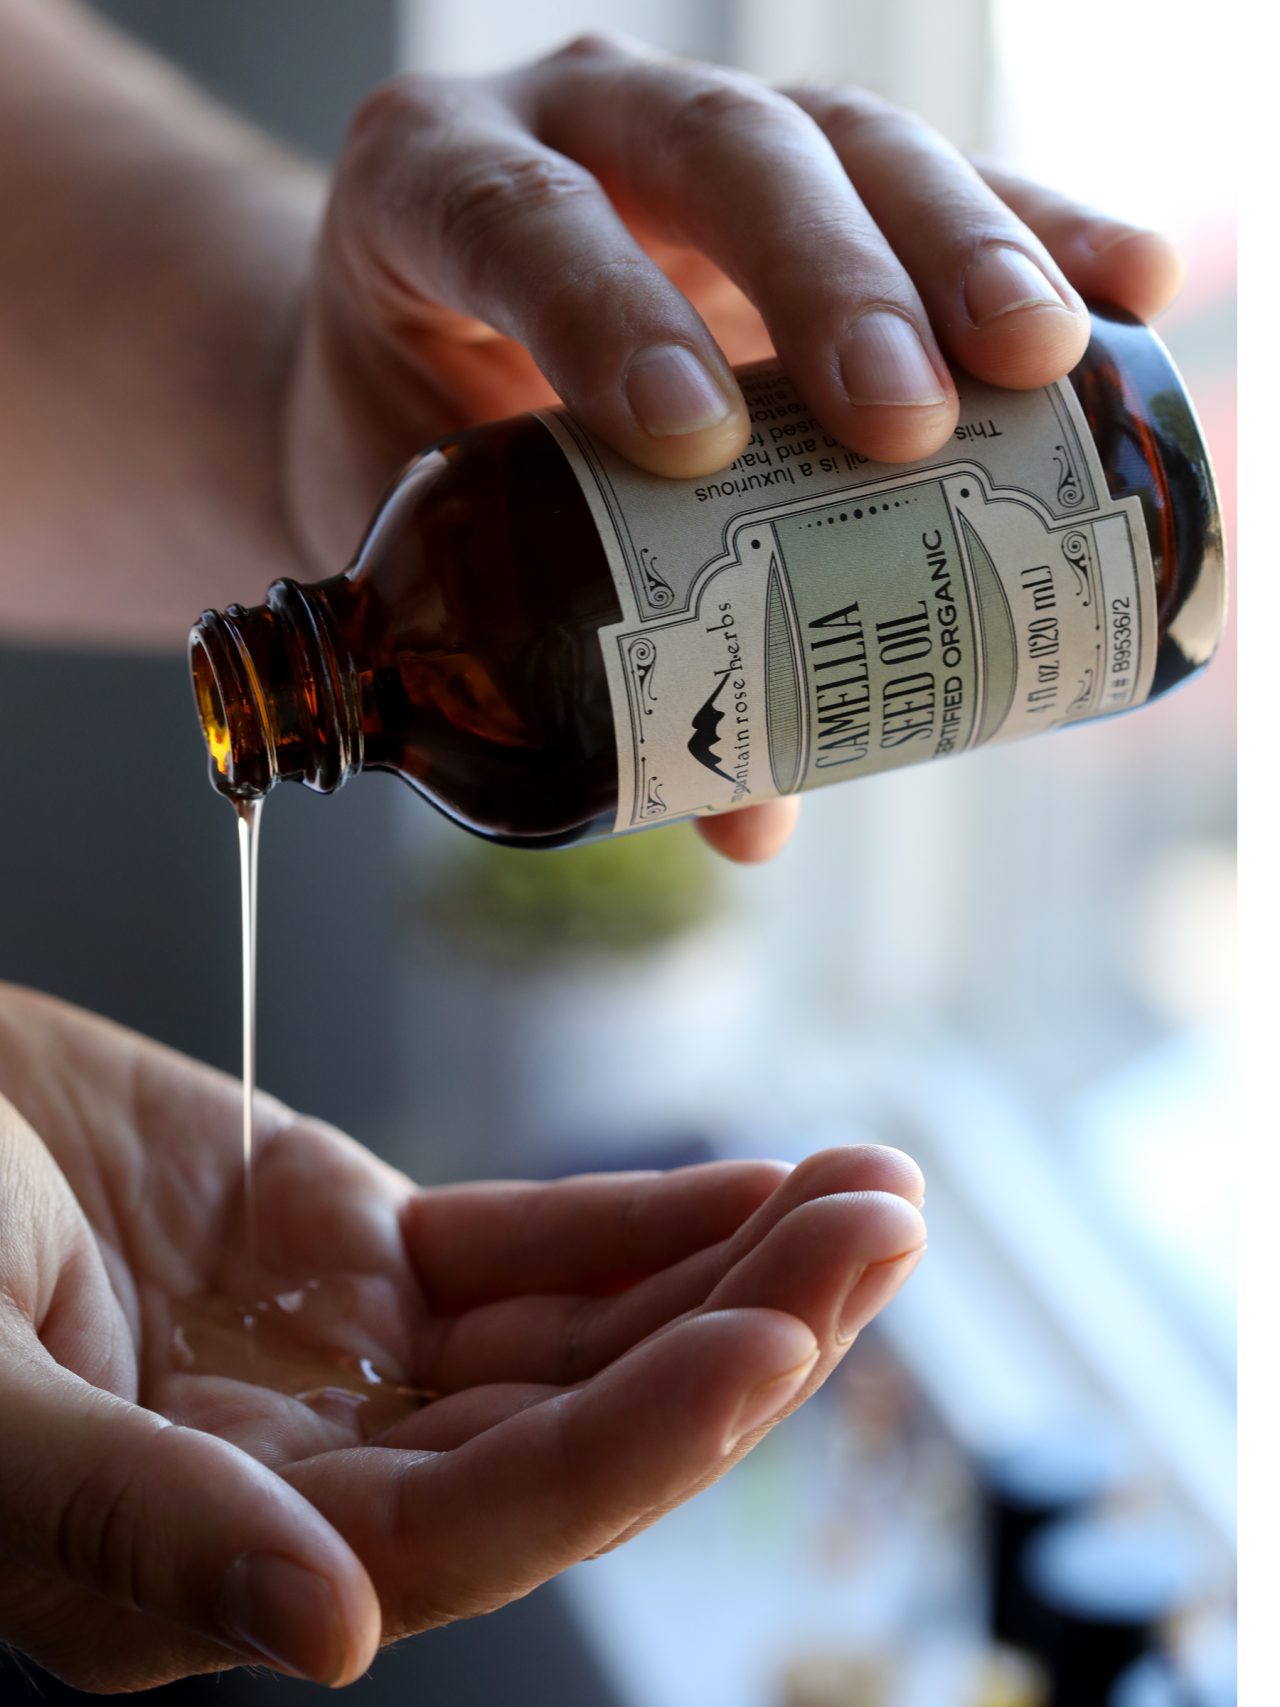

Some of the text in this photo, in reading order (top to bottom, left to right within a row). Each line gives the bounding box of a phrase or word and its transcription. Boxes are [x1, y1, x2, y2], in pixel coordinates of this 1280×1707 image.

[953, 419, 1003, 443] This
[731, 450, 773, 473] hair
[776, 439, 817, 463] and
[798, 462, 814, 477] a
[819, 456, 841, 475] is
[694, 466, 796, 502] luxurious
[922, 529, 962, 669] ORGANIC
[1020, 565, 1056, 611] mL)
[706, 602, 743, 677] herbs
[1027, 617, 1060, 659] (120
[1112, 596, 1131, 674] B9536/2
[808, 601, 871, 769] CAMELLIA
[875, 600, 936, 749] SEED OIL
[1038, 660, 1060, 684] oz
[733, 678, 750, 724] rose
[1027, 686, 1059, 703] fl
